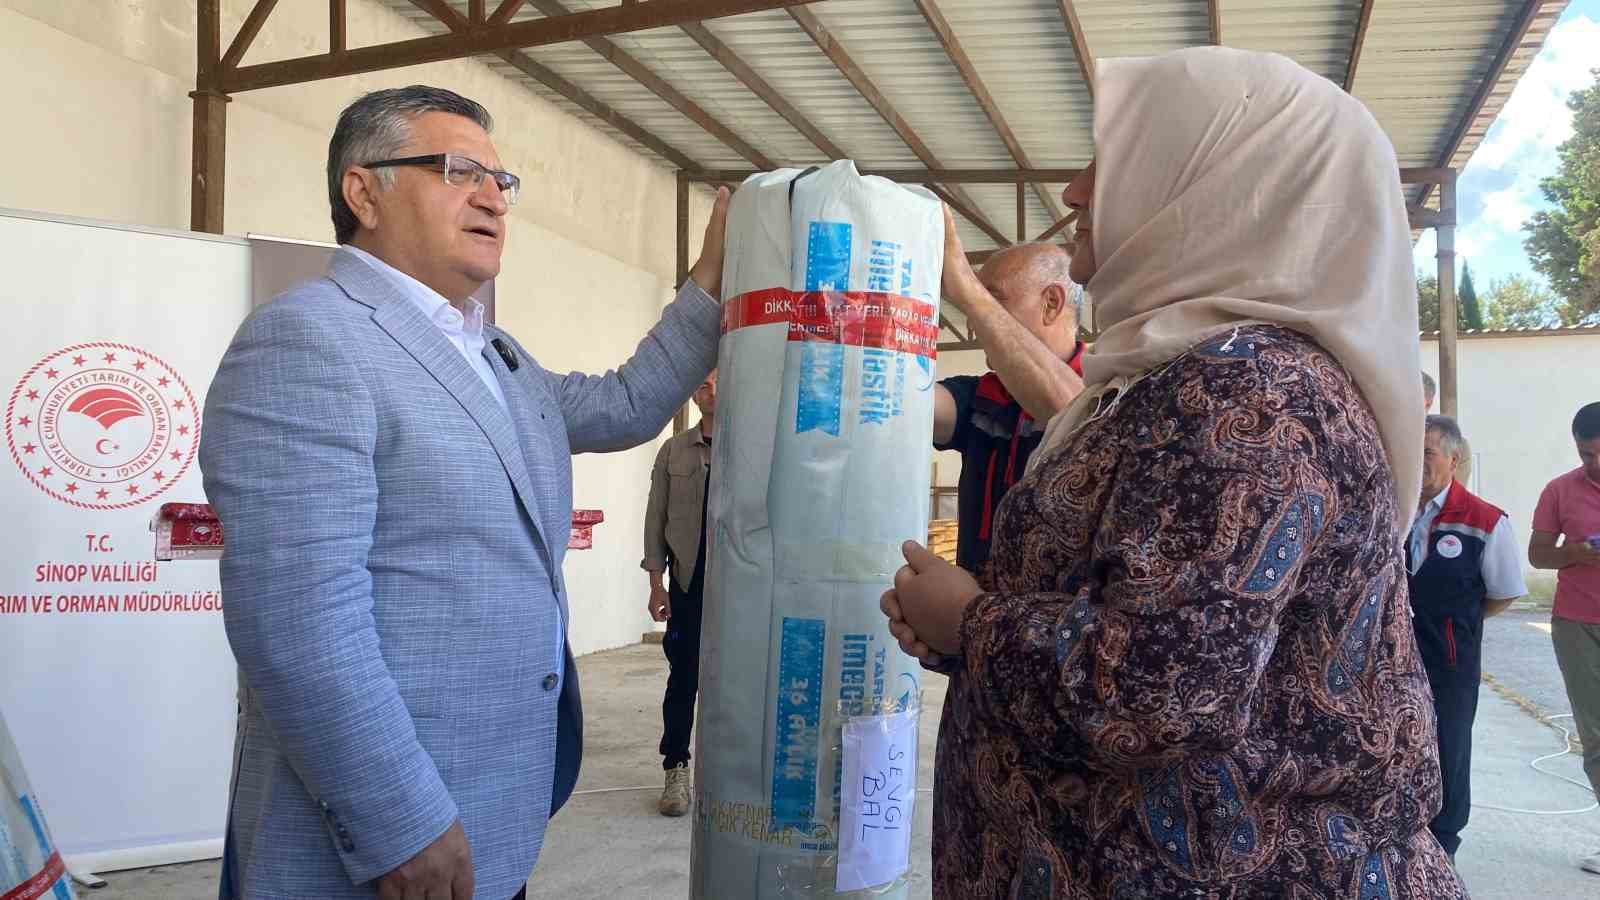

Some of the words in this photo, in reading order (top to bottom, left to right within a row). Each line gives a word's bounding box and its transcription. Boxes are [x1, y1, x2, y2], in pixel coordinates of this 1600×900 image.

[91, 372, 130, 385] TARIM
[133, 381, 147, 394] VE
[43, 376, 89, 440] CUMHURİYETİ
[146, 393, 167, 432] ORMAN
[48, 440, 93, 477] TÜRKİYE
[117, 433, 165, 478] BAKANLIĞI
[86, 534, 114, 552] T.C.
[36, 560, 88, 582] SİNOP
[91, 560, 157, 582] VALİLİĞİ
[0, 595, 27, 613] RIM
[32, 595, 53, 613] VE
[56, 594, 119, 613] ORMAN
[123, 590, 223, 612] MÜDÜRLÜĞÜ
[790, 677, 809, 705] 36
[862, 771, 887, 842] BAL
